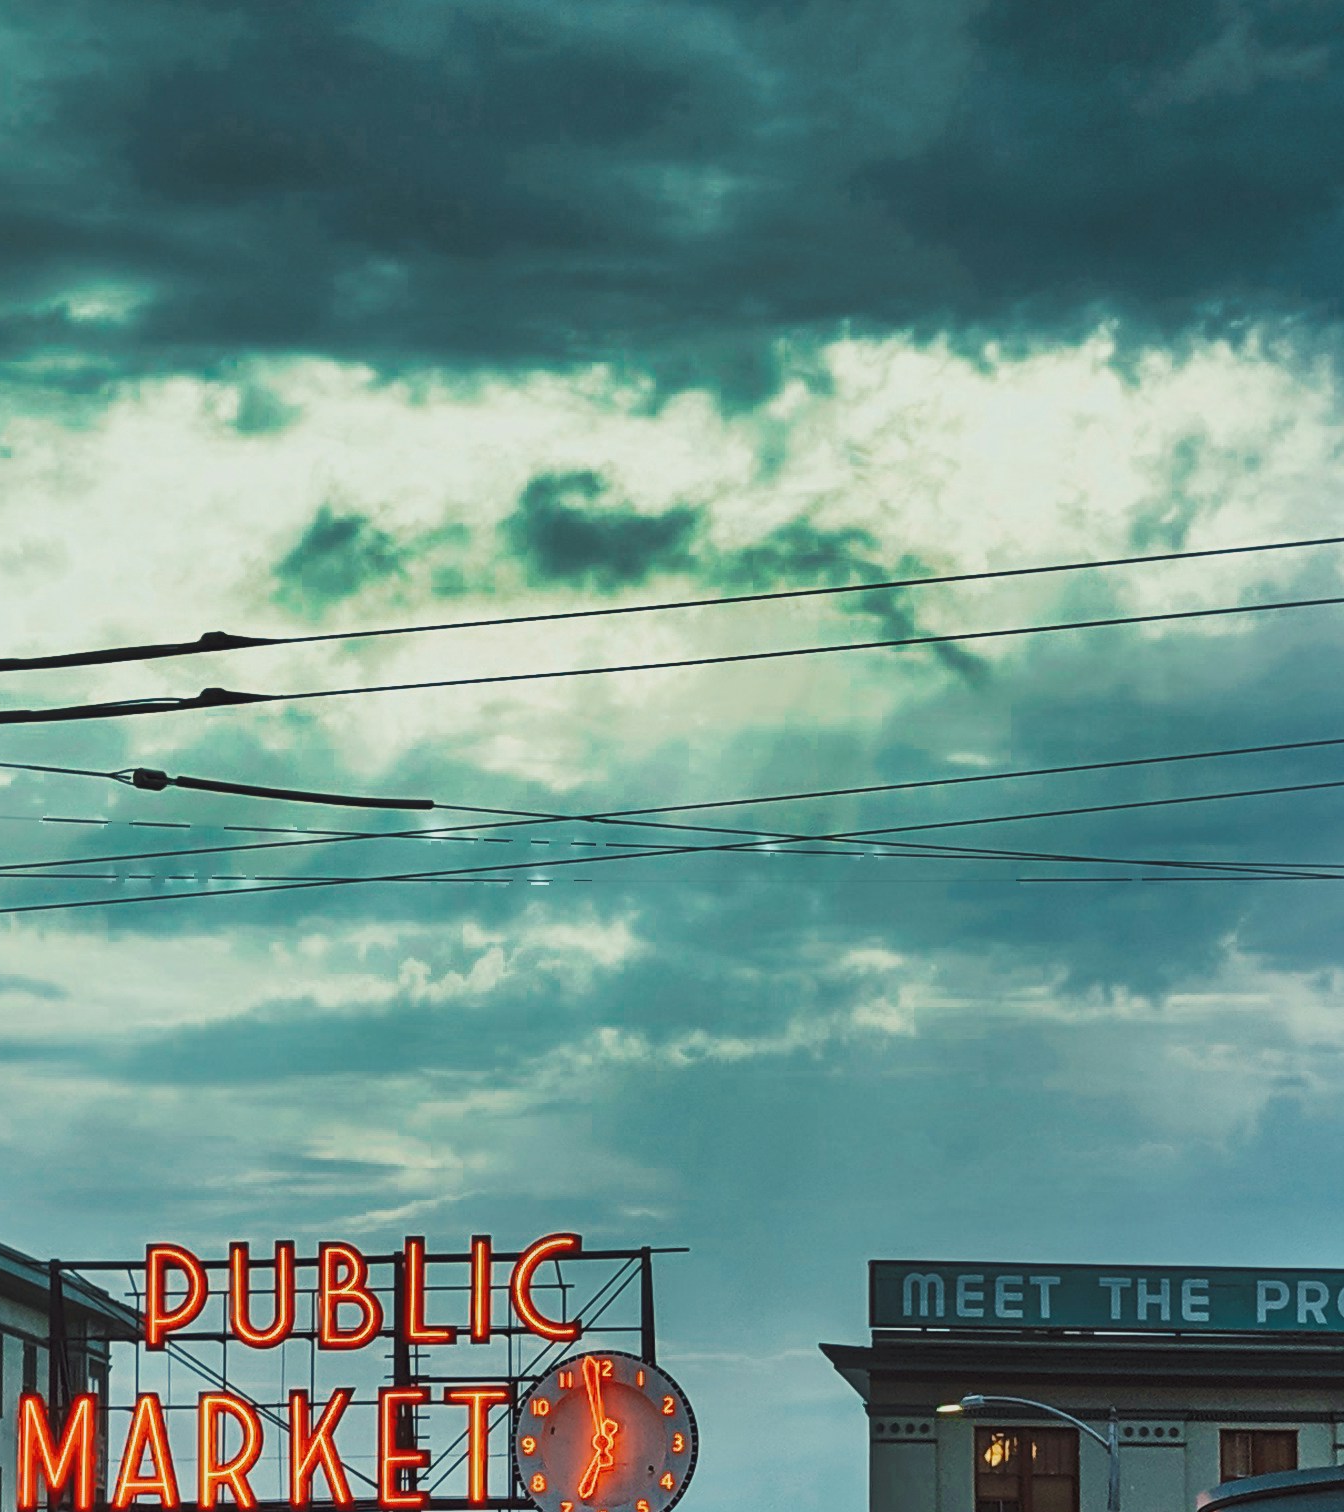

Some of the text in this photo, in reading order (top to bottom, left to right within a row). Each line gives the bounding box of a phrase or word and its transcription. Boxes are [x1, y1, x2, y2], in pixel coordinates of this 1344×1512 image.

[145, 1232, 582, 1351] PUBLIC
[902, 1272, 1061, 1318] MEET
[1099, 1276, 1210, 1322] THE
[559, 1371, 573, 1388] 11
[532, 1400, 550, 1416] 10
[662, 1395, 674, 1414] 2
[521, 1437, 536, 1454] 9
[673, 1433, 684, 1452] 3
[532, 1474, 545, 1492] 8
[660, 1473, 673, 1490] 4
